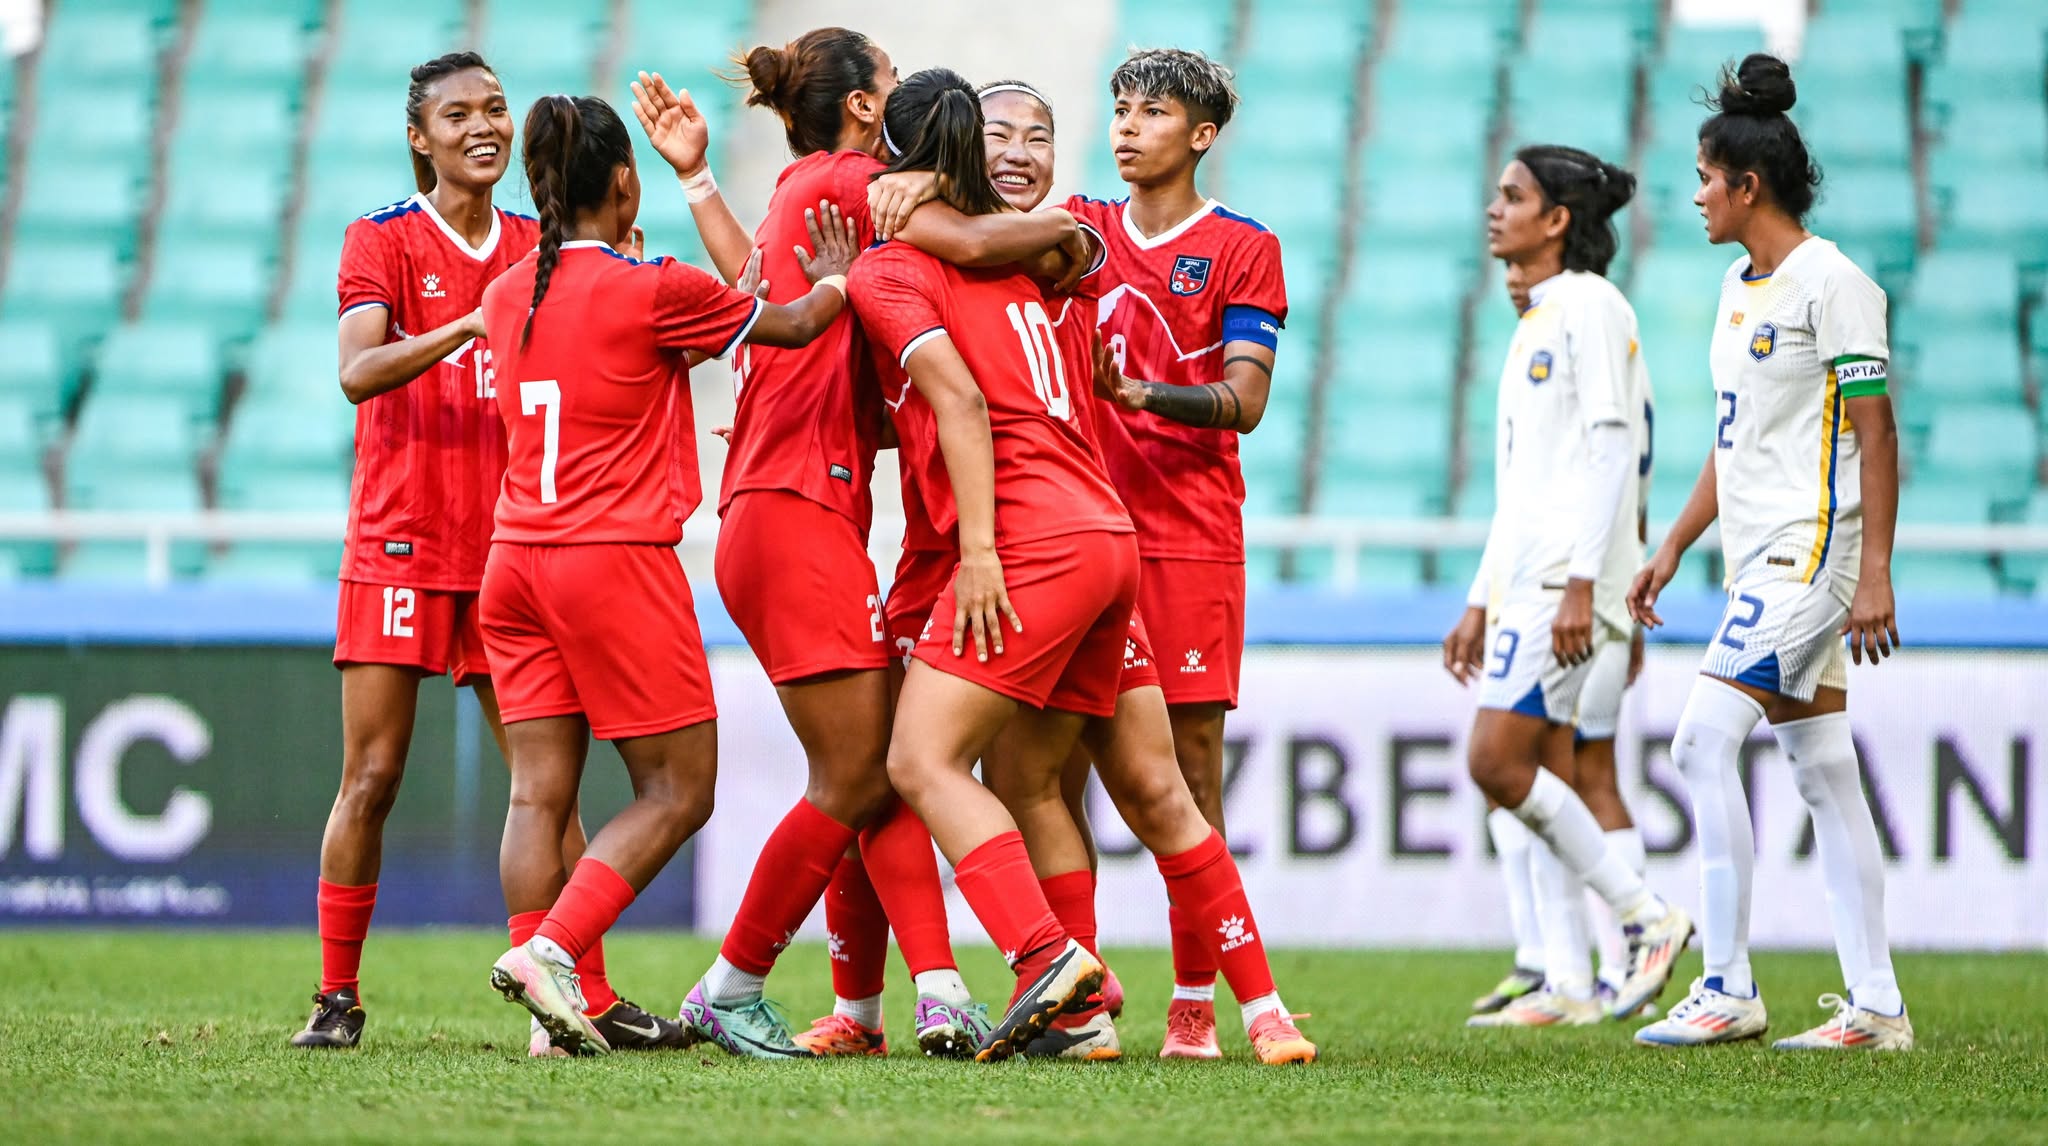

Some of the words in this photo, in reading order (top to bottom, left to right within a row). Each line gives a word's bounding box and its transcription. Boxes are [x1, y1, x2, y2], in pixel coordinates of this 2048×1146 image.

[473, 349, 497, 399] 12
[1005, 301, 1070, 422] 10
[1836, 363, 1886, 381] CAPTAIN
[519, 379, 561, 505] 7
[382, 586, 416, 638] 12
[1180, 665, 1208, 673] KELME
[1488, 628, 1520, 680] 9
